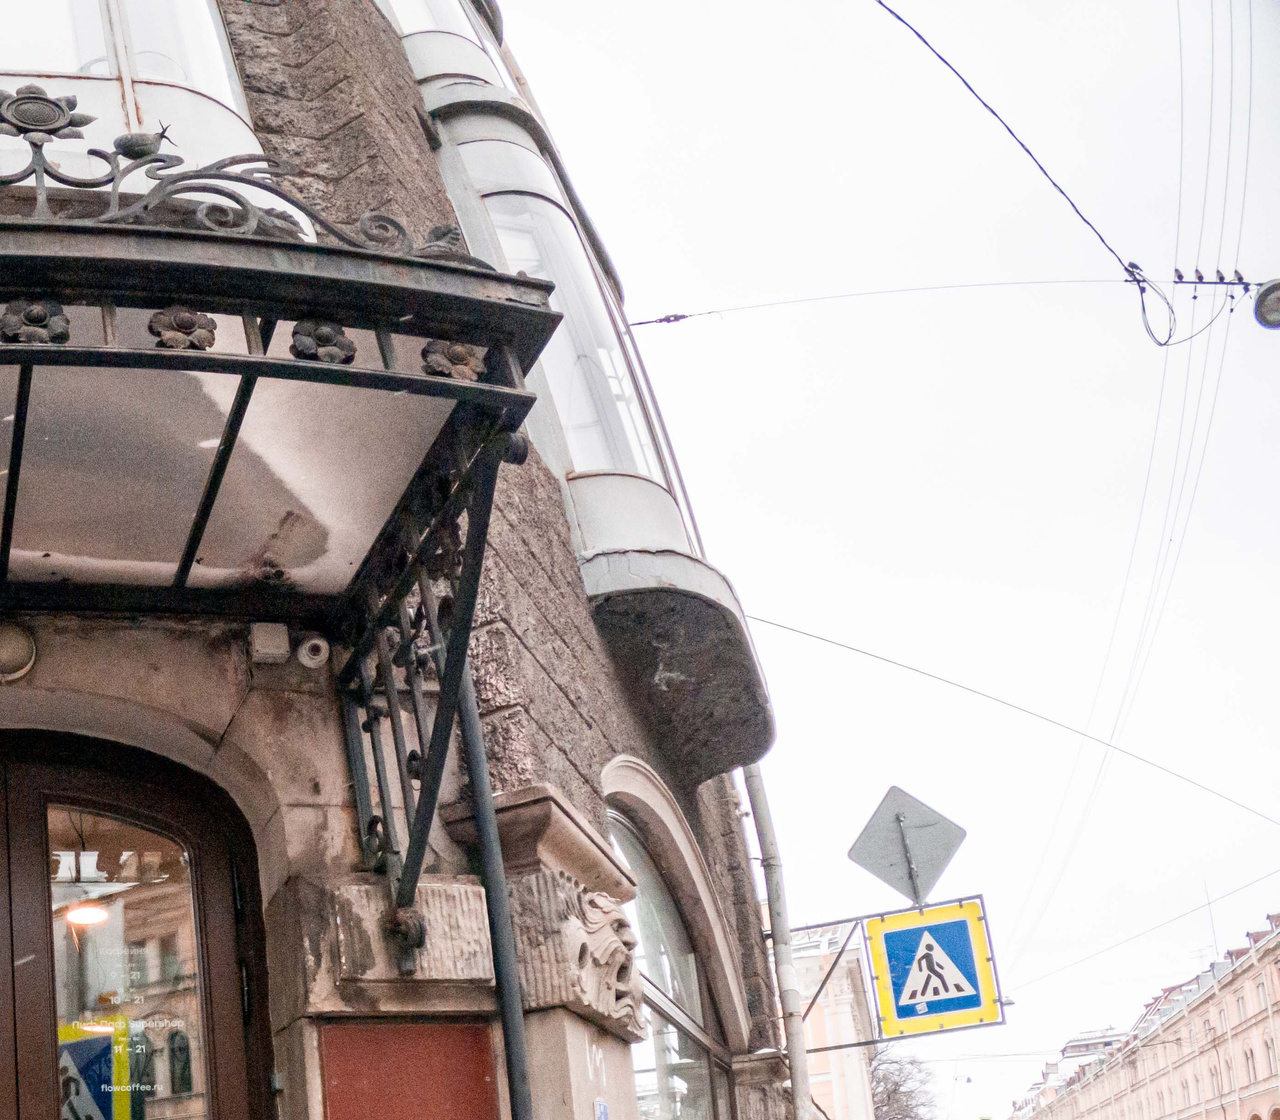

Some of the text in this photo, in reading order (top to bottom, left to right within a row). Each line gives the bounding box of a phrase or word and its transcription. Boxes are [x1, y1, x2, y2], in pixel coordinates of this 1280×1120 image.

[130, 971, 141, 979] 21
[110, 996, 121, 1004] 10
[134, 996, 145, 1004] 21
[129, 1018, 185, 1029] supershop
[114, 1045, 123, 1053] 11
[135, 1045, 146, 1054] 21
[101, 1083, 163, 1092] flowcoffee.ru
